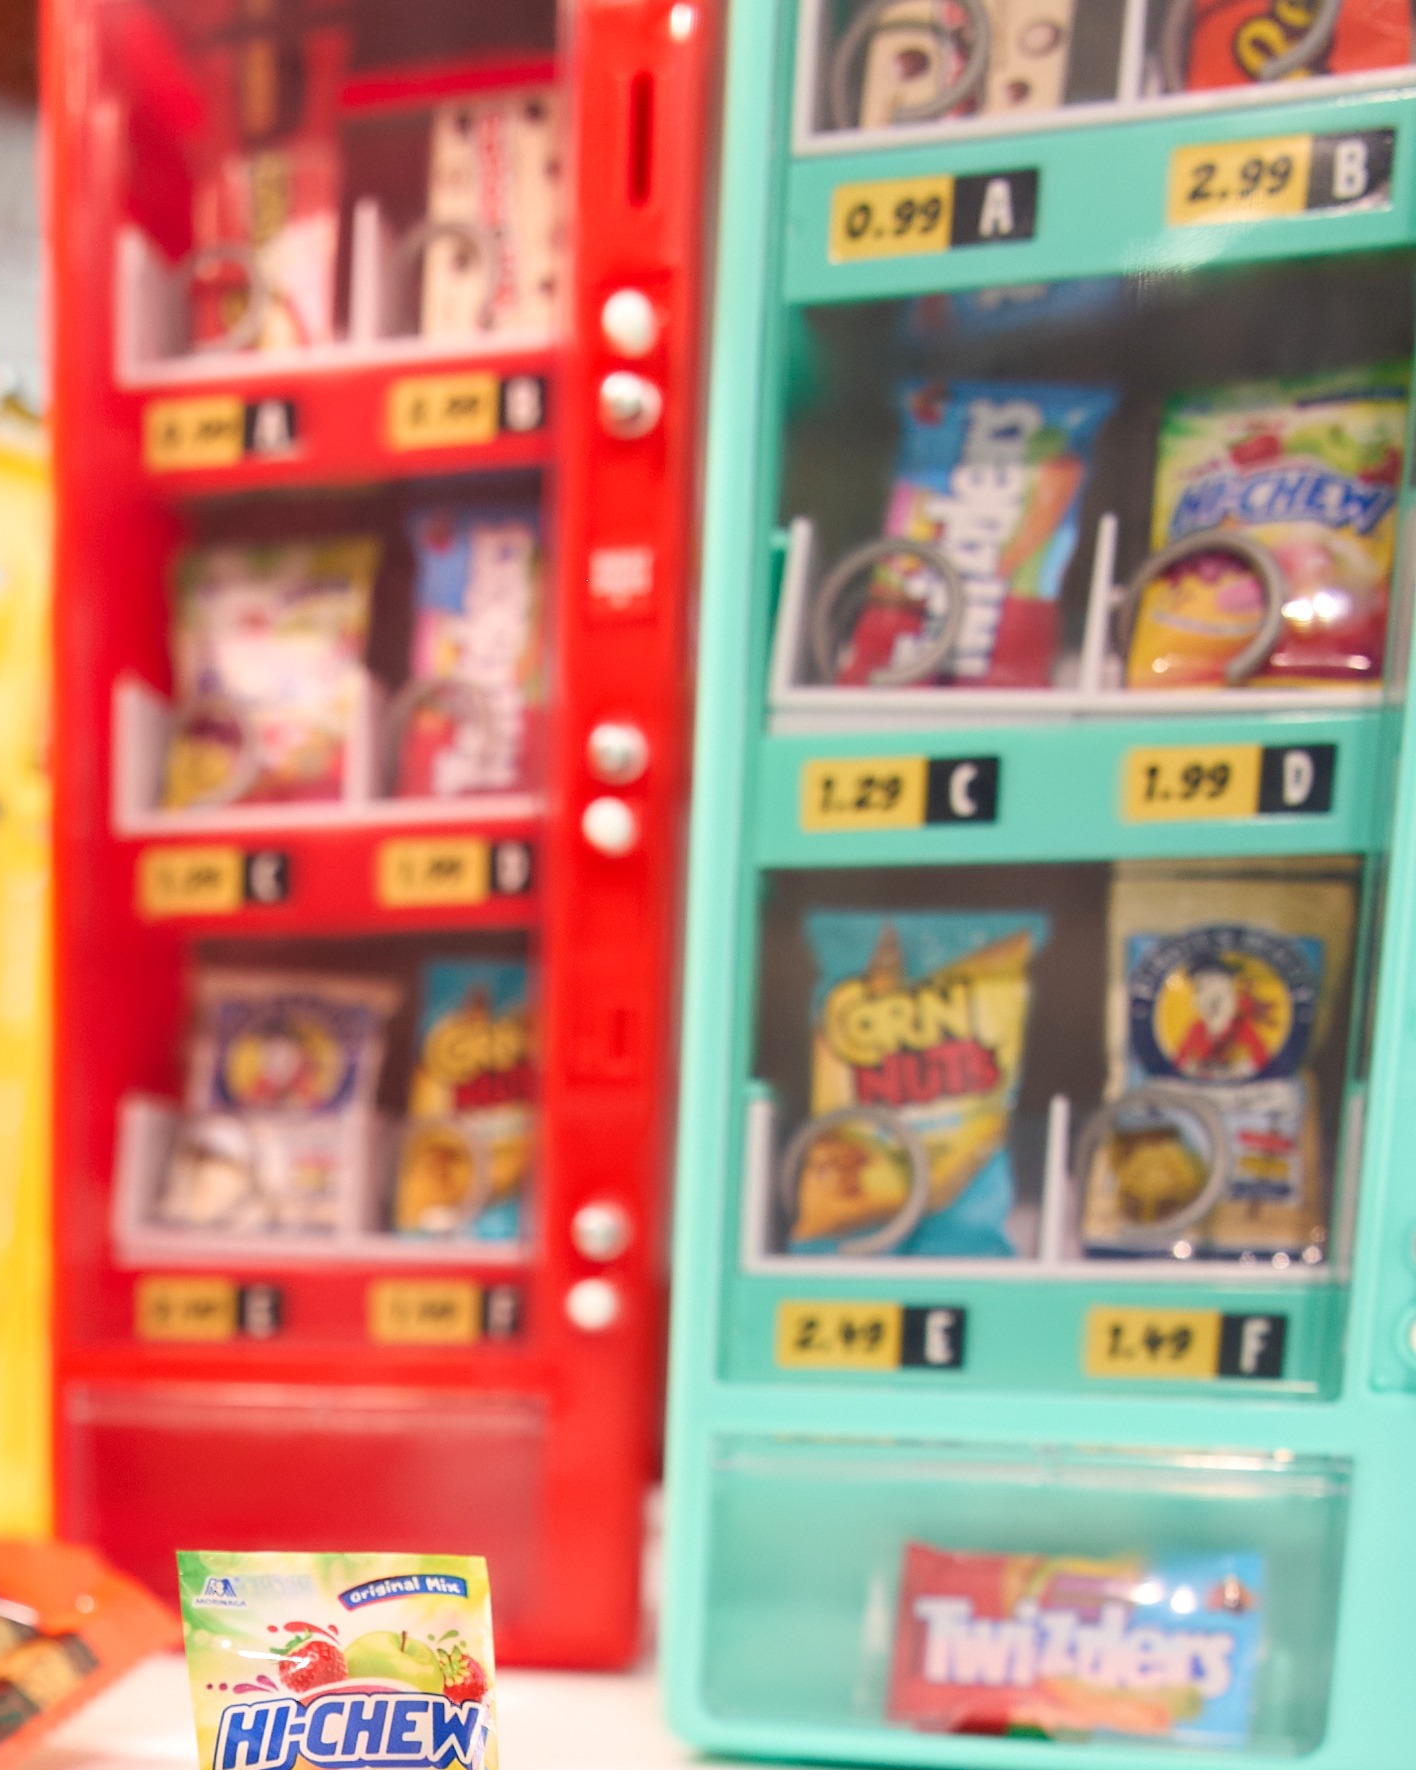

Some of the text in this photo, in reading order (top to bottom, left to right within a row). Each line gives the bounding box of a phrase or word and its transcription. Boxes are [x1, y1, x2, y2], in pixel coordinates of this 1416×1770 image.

[1189, 140, 1369, 201] 2.99 B
[844, 180, 1014, 239] 0.99 A
[818, 765, 978, 817] 1.29 C
[1144, 753, 1314, 806] 1.99 D
[1239, 1316, 1271, 1367] F
[349, 1576, 462, 1604] Original Mix
[913, 1595, 1236, 1702] Twizzlers
